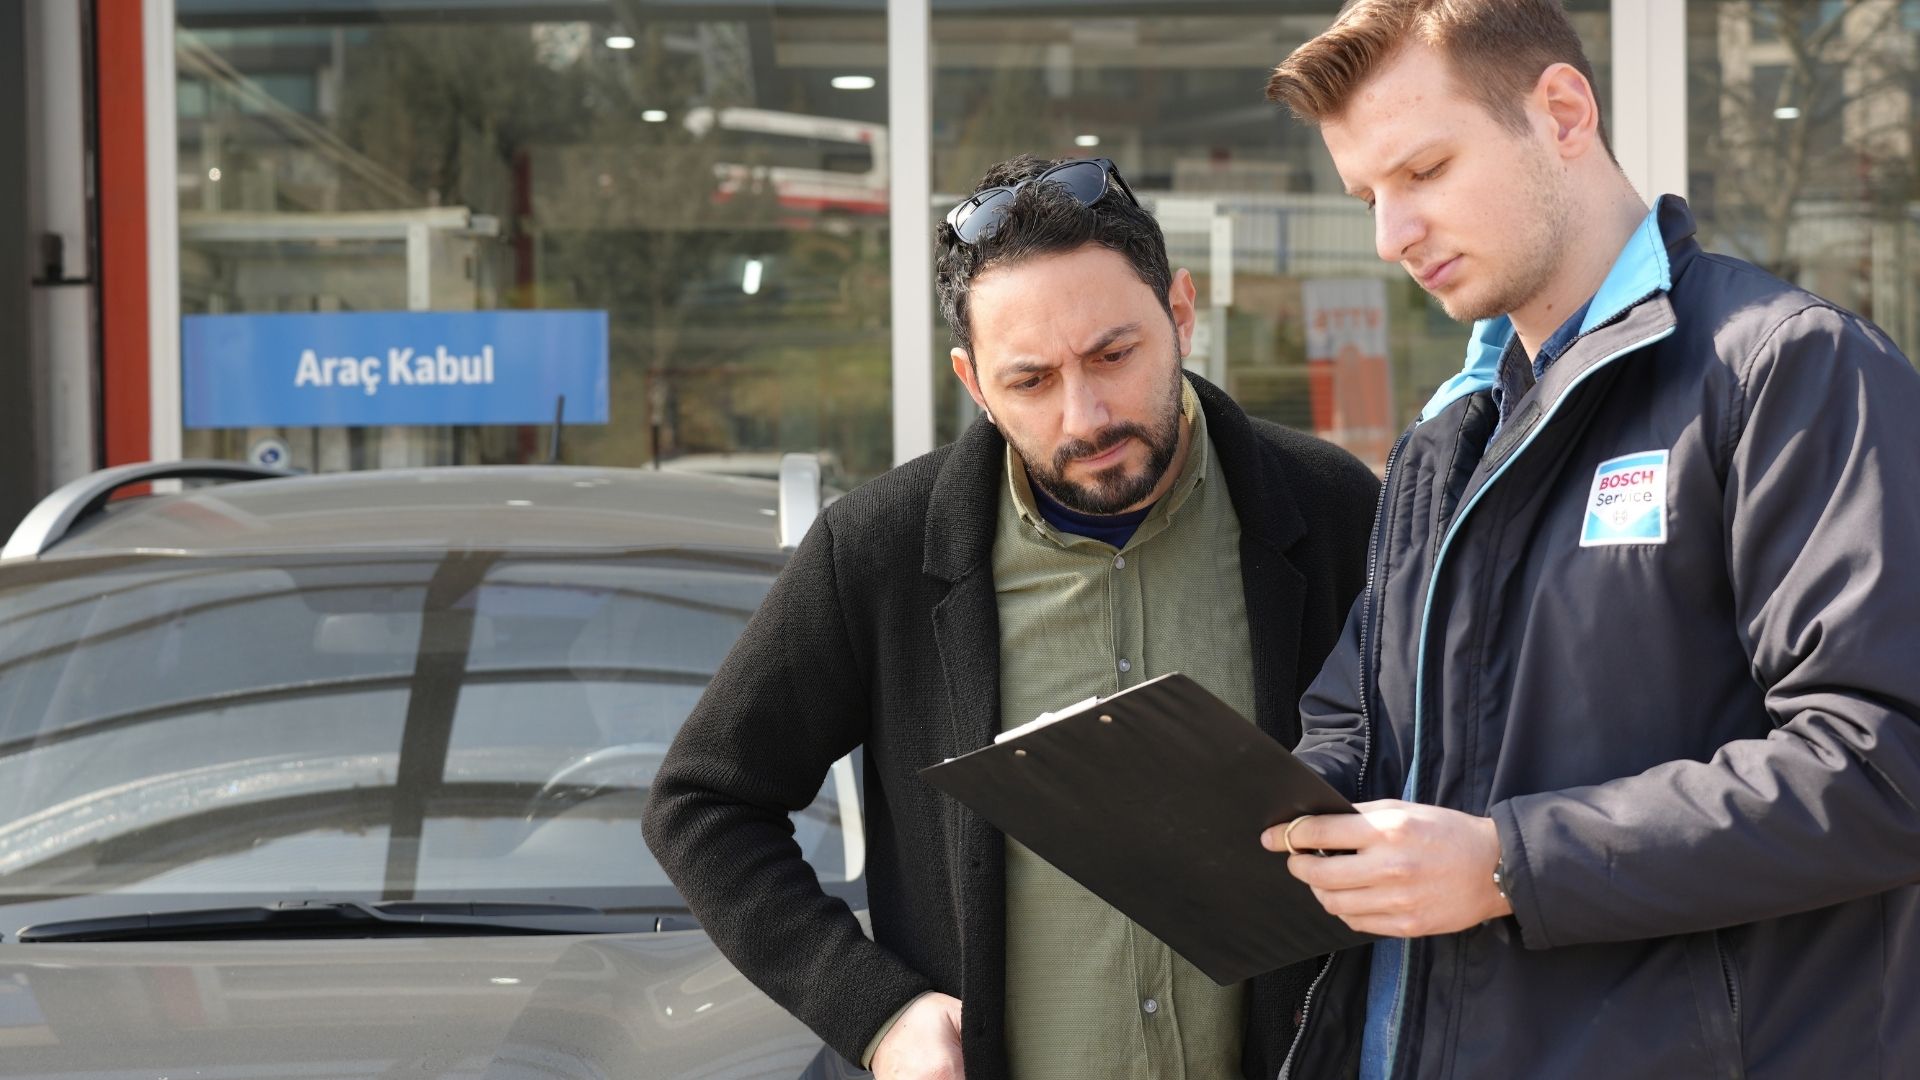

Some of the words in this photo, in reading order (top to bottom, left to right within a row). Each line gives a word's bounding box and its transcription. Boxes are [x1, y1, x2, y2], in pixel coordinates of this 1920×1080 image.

[295, 348, 381, 395] Araç
[388, 345, 494, 384] Kabul
[1599, 470, 1654, 490] BOSCH
[1596, 491, 1652, 507] Service
